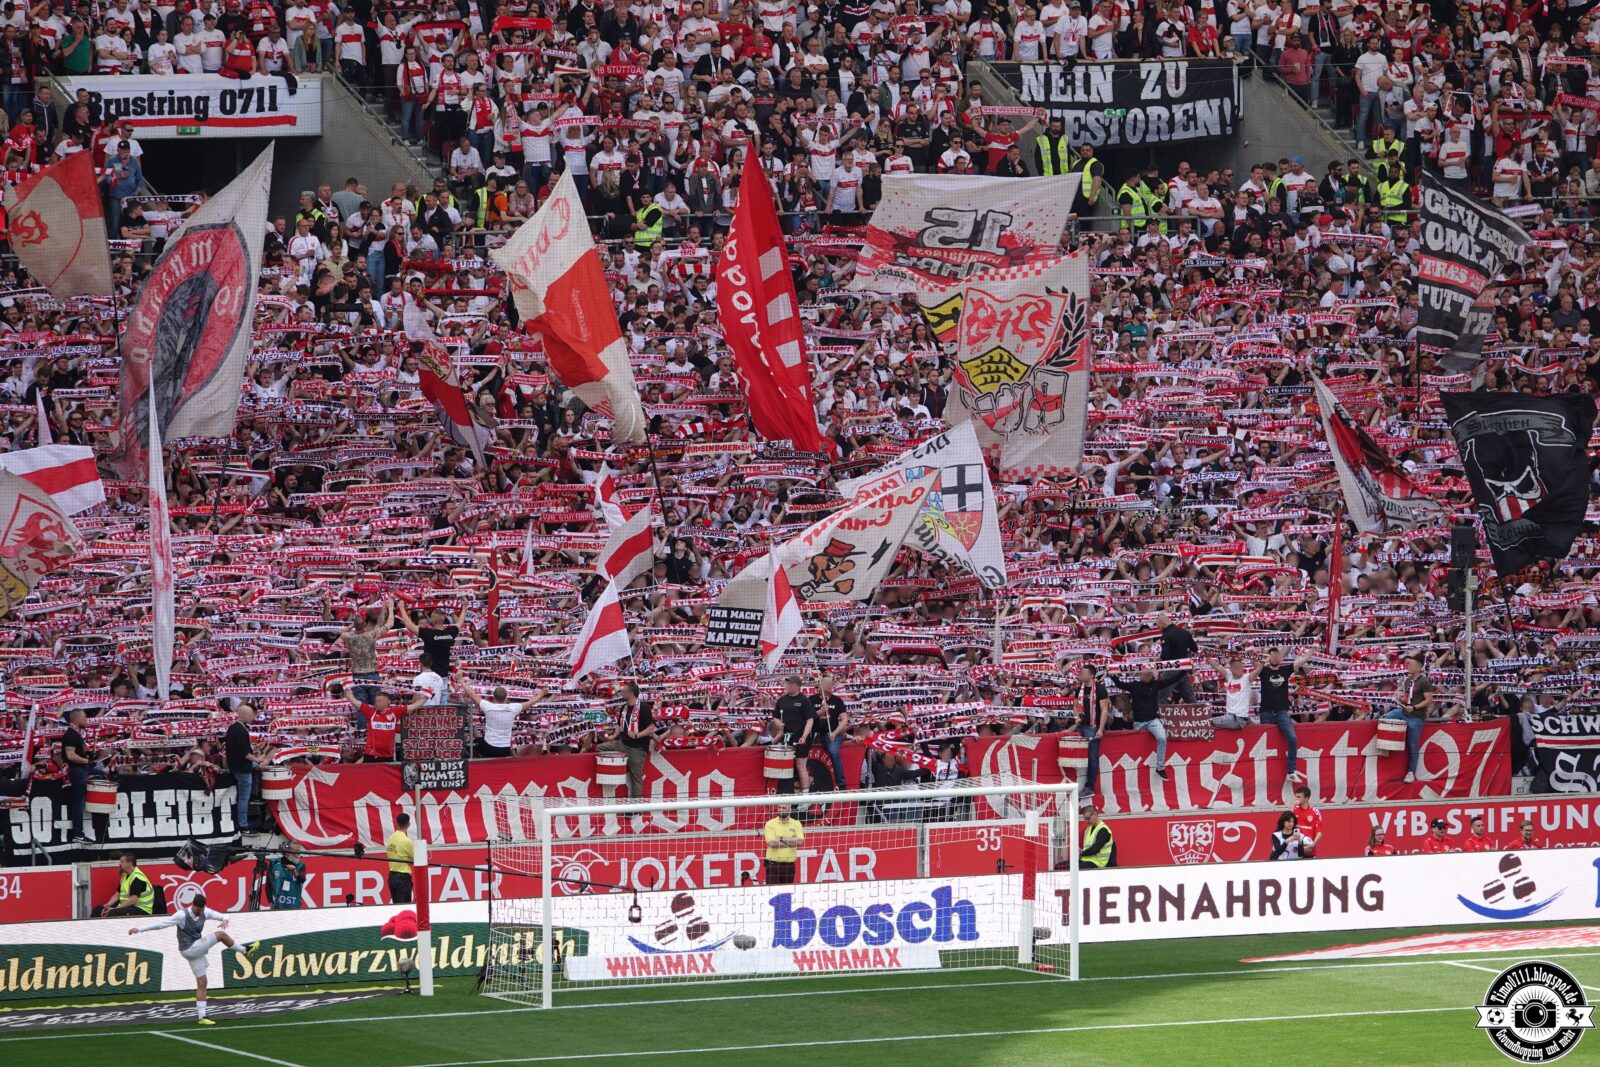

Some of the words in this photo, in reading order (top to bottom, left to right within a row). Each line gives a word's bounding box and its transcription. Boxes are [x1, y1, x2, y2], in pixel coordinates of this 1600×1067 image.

[1020, 63, 1115, 104] NEIN
[1140, 61, 1188, 100] ZU
[89, 90, 210, 121] Brustring
[219, 85, 278, 116] 0711
[709, 608, 728, 619] IHR
[729, 608, 763, 621] MACHT
[708, 619, 727, 629] DEN
[728, 620, 761, 632] VEREIN
[706, 630, 758, 647] KAPUTT
[1154, 659, 1181, 670] RAS
[876, 695, 940, 709] COMMANDO
[405, 707, 457, 717] JEDER
[1157, 706, 1189, 717] LTRA
[1190, 707, 1212, 717] IST
[402, 716, 464, 729] VERBANNTE
[1529, 714, 1600, 735] SCHW
[407, 729, 458, 739] KEHRT
[549, 720, 595, 740] OMMAND
[948, 725, 974, 737] RAS
[1180, 729, 1216, 739] GANZE
[662, 738, 683, 747] CC
[701, 736, 720, 746] 97
[403, 749, 462, 760] ZURÜCK
[871, 740, 893, 752] CC
[910, 753, 932, 765] 97
[420, 763, 437, 772] DU
[440, 761, 465, 771] BIST
[1414, 726, 1502, 800] 97
[420, 771, 466, 782] IMMER
[441, 778, 466, 789] UNS!
[276, 750, 737, 848] Commando
[107, 783, 238, 840] BLEIBT
[1368, 809, 1429, 837] VfB
[976, 828, 1001, 852] 35
[1054, 873, 1385, 928] TIERNAHRUNG
[768, 885, 980, 950] bosch
[605, 952, 716, 978] WINAMAX
[792, 948, 902, 972] WINAMAX
